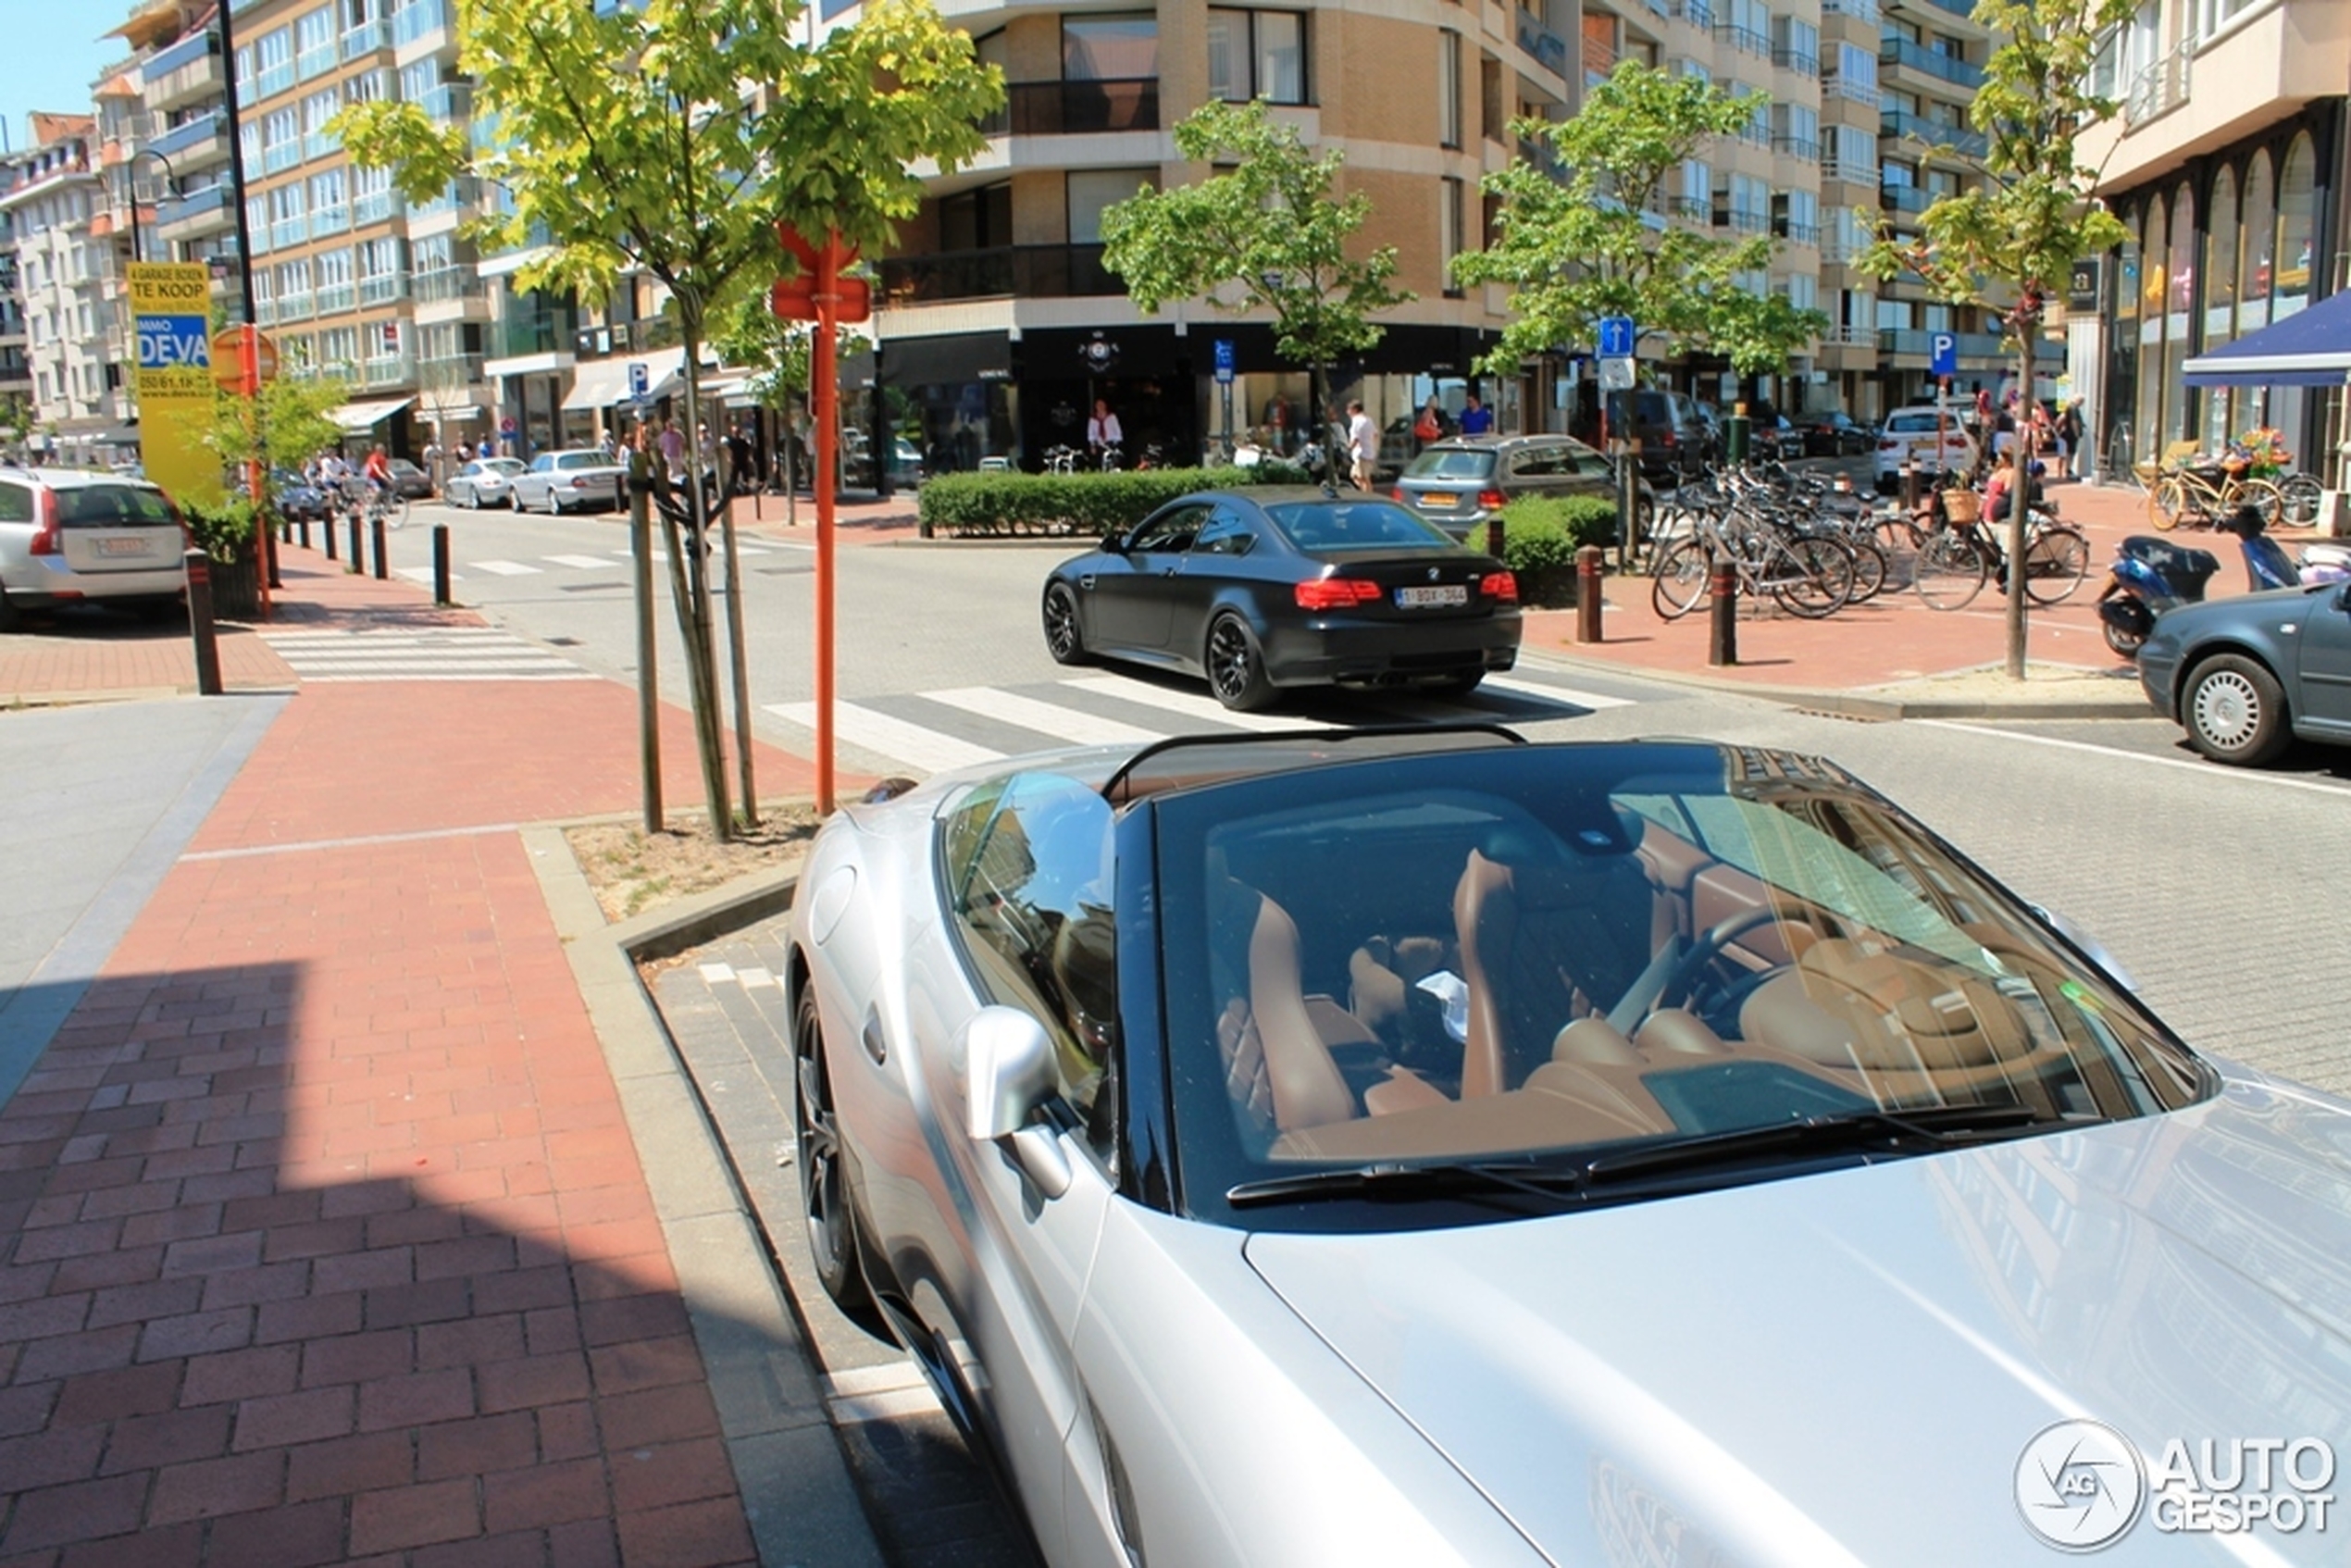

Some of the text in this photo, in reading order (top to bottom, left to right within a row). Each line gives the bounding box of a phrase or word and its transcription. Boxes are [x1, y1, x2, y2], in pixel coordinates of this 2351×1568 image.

[138, 268, 173, 280] GARAGE
[174, 268, 203, 280] BOXEN
[133, 282, 205, 298] TE KOOP
[138, 319, 173, 332] IMMO
[138, 334, 210, 365] DEVA
[1935, 335, 1952, 361] P
[631, 367, 646, 393] P
